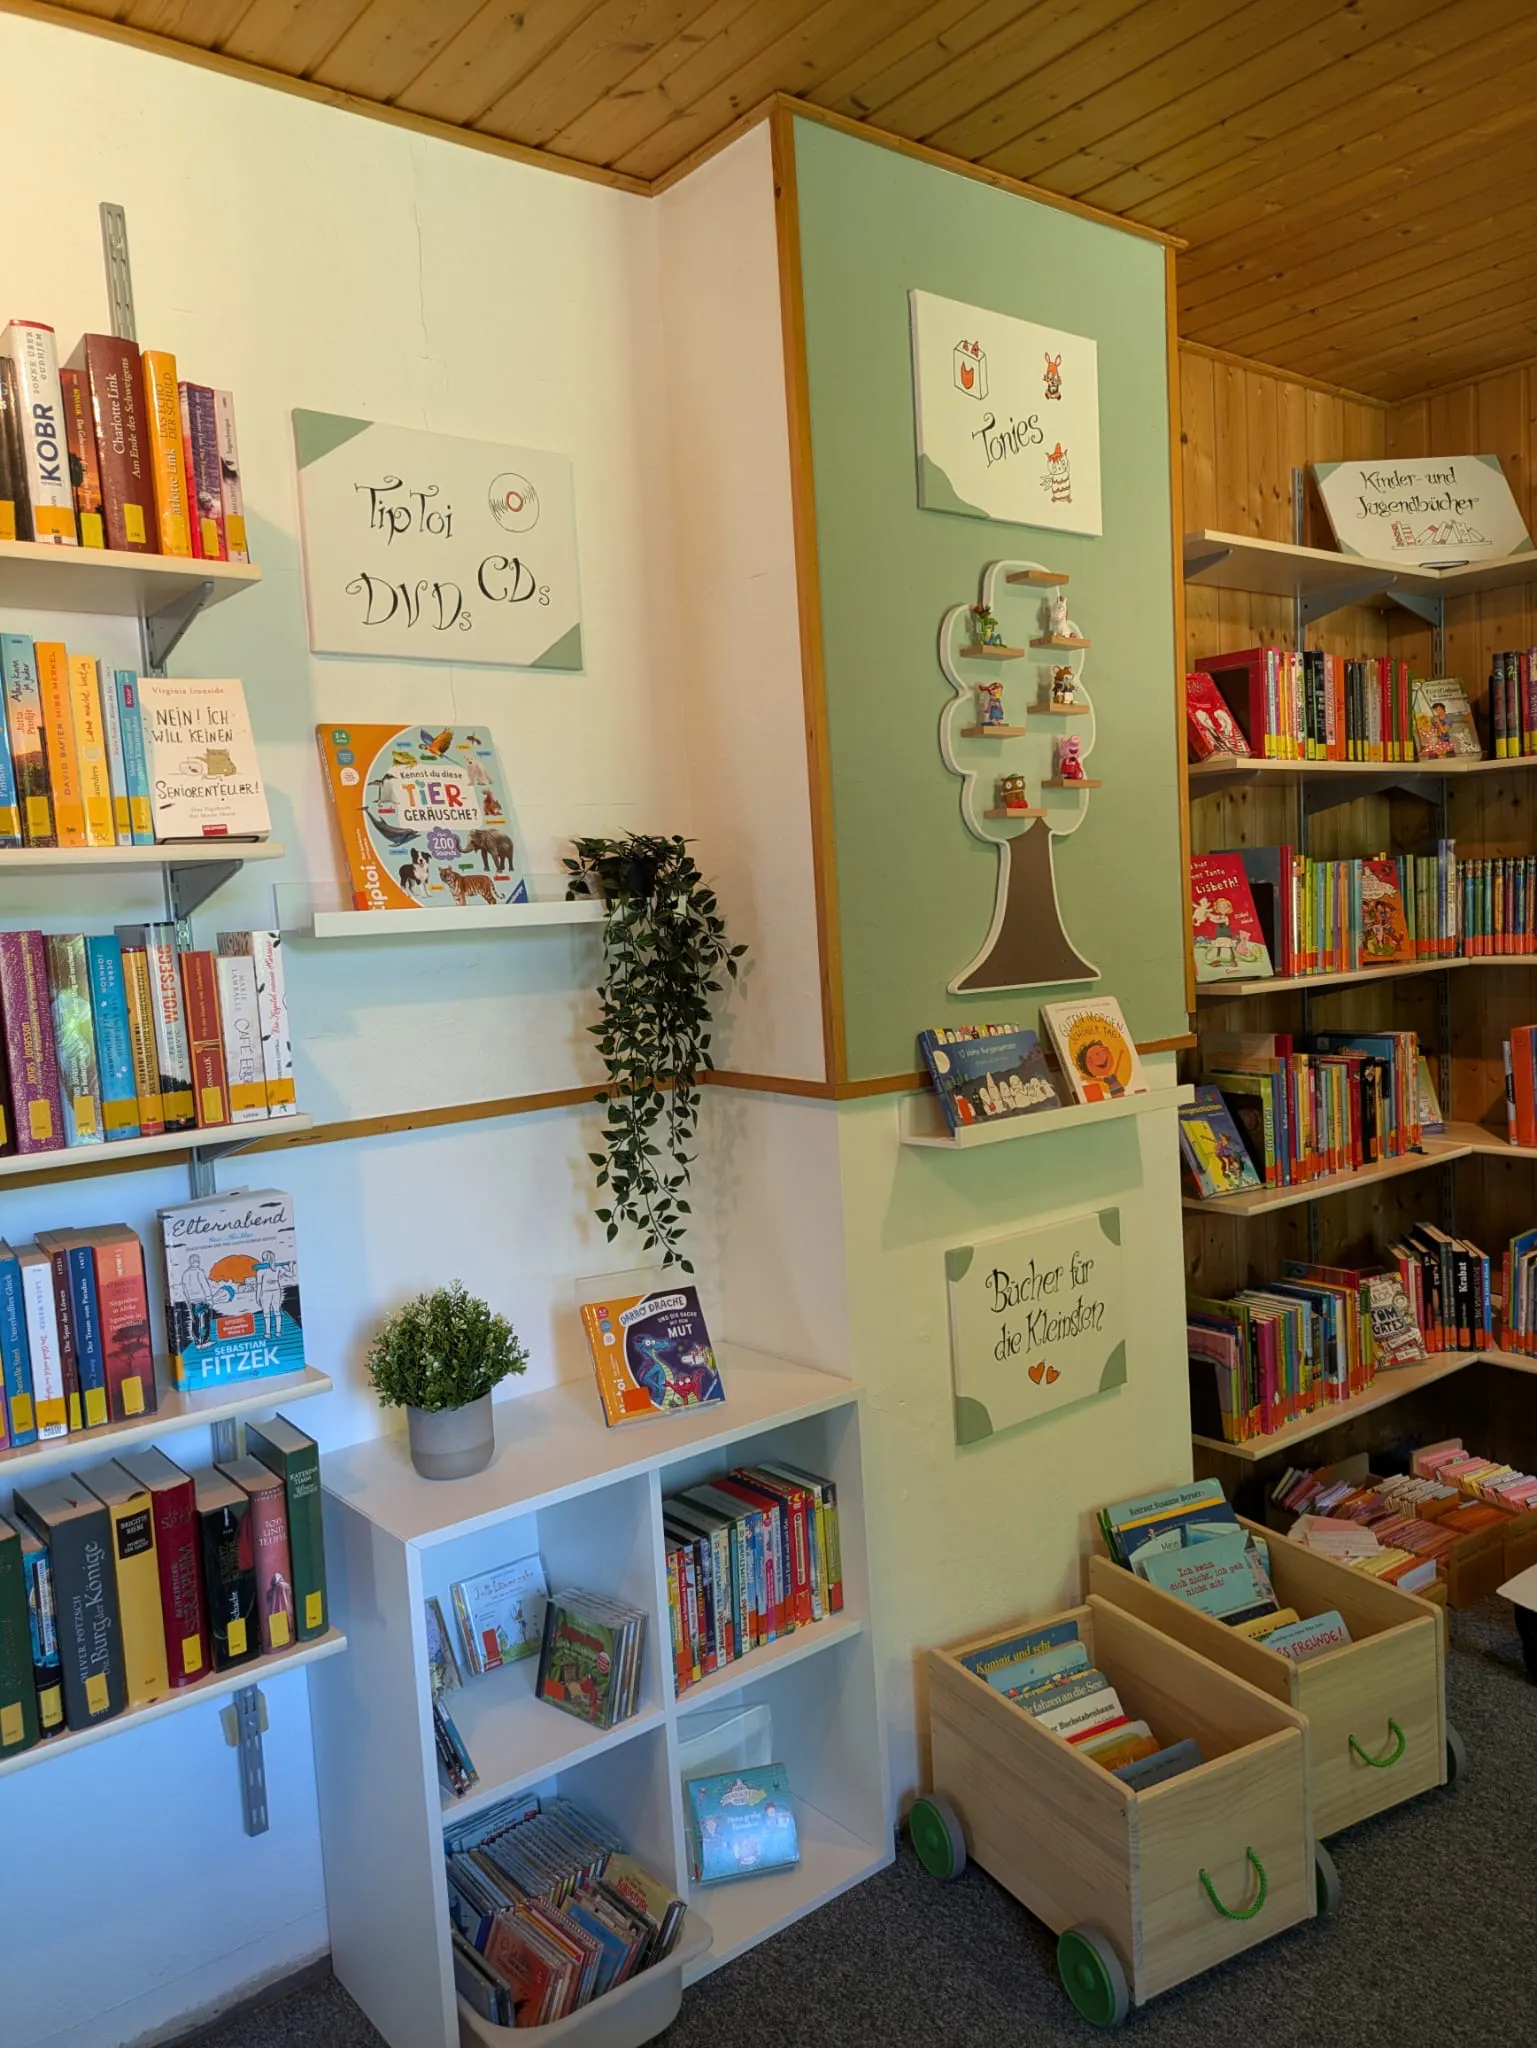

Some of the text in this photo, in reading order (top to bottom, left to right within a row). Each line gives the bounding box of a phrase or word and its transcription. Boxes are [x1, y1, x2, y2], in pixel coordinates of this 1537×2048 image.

[105, 372, 125, 455] Charlotte Link
[121, 356, 142, 480] Am Ende des Schweigens
[162, 372, 177, 440] DER SCHULD
[32, 403, 62, 482] KOBR
[971, 412, 1044, 468] Tonies
[166, 447, 182, 517] arlotte Link
[1426, 466, 1457, 486] und
[1356, 492, 1479, 519] Jugendbücher
[345, 555, 551, 631] DVDs CDs
[49, 651, 61, 691] MERKEL
[152, 686, 187, 696] Virginia
[15, 711, 25, 734] Jutta
[151, 728, 233, 744] WILL KEINEN
[58, 723, 69, 759] SAFIER
[64, 762, 72, 797] DAVID
[90, 764, 101, 797] aunders
[399, 769, 463, 780] Kennst du diese
[403, 806, 478, 822] GERÄUSCHE?
[432, 837, 455, 850] 200
[1195, 876, 1240, 895] Lisbeth!
[1205, 868, 1225, 878] Tante
[97, 954, 107, 994] JOHNSON
[157, 944, 179, 1025] WOLFSEGG
[238, 974, 248, 1001] MARIE
[233, 1017, 254, 1055] CAFÉ
[1059, 1013, 1085, 1038] GUTEN
[22, 1022, 37, 1085] Jonas Jonasson
[70, 1058, 80, 1086] Jonasson
[204, 1056, 213, 1087] ONSALIK
[172, 1207, 288, 1237] Elternabend
[3, 1273, 14, 1297] Glück
[985, 1250, 1095, 1314] Bücher für
[1458, 1261, 1468, 1294] Krabat
[58, 1290, 68, 1312] Löwen
[80, 1278, 91, 1305] Paradies
[647, 1295, 685, 1313] DRACHE
[5, 1294, 20, 1342] Unverhofftes
[1370, 1305, 1399, 1323] TOM
[1371, 1319, 1405, 1336] GATES
[62, 1323, 72, 1340] Spur
[84, 1319, 94, 1339] Traum
[667, 1323, 693, 1339] MUT
[994, 1295, 1105, 1361] die Kleinsten
[12, 1347, 22, 1366] Steel
[86, 1340, 95, 1354] Der
[214, 1340, 267, 1356] SEBASTIAN
[201, 1346, 281, 1378] FITZEK
[1128, 1490, 1202, 1516] Rotraut Susanne Berner
[263, 1525, 285, 1537] UND
[264, 1517, 282, 1528] TOD
[258, 1531, 288, 1547] TEUFEL
[1160, 1541, 1180, 1551] Mein
[82, 1541, 107, 1608] Könige
[1177, 1566, 1194, 1577] Ich
[181, 1543, 199, 1634] SERAPHIM
[93, 1603, 105, 1619] der
[72, 1595, 90, 1684] OLIVER PÖTZSCH
[90, 1616, 112, 1665] Burg
[1291, 1626, 1344, 1657] FREUNDE!
[1013, 1644, 1031, 1663] und
[1032, 1679, 1104, 1713] fahren an die See
[1058, 1702, 1116, 1732] Buchstabenbaum
